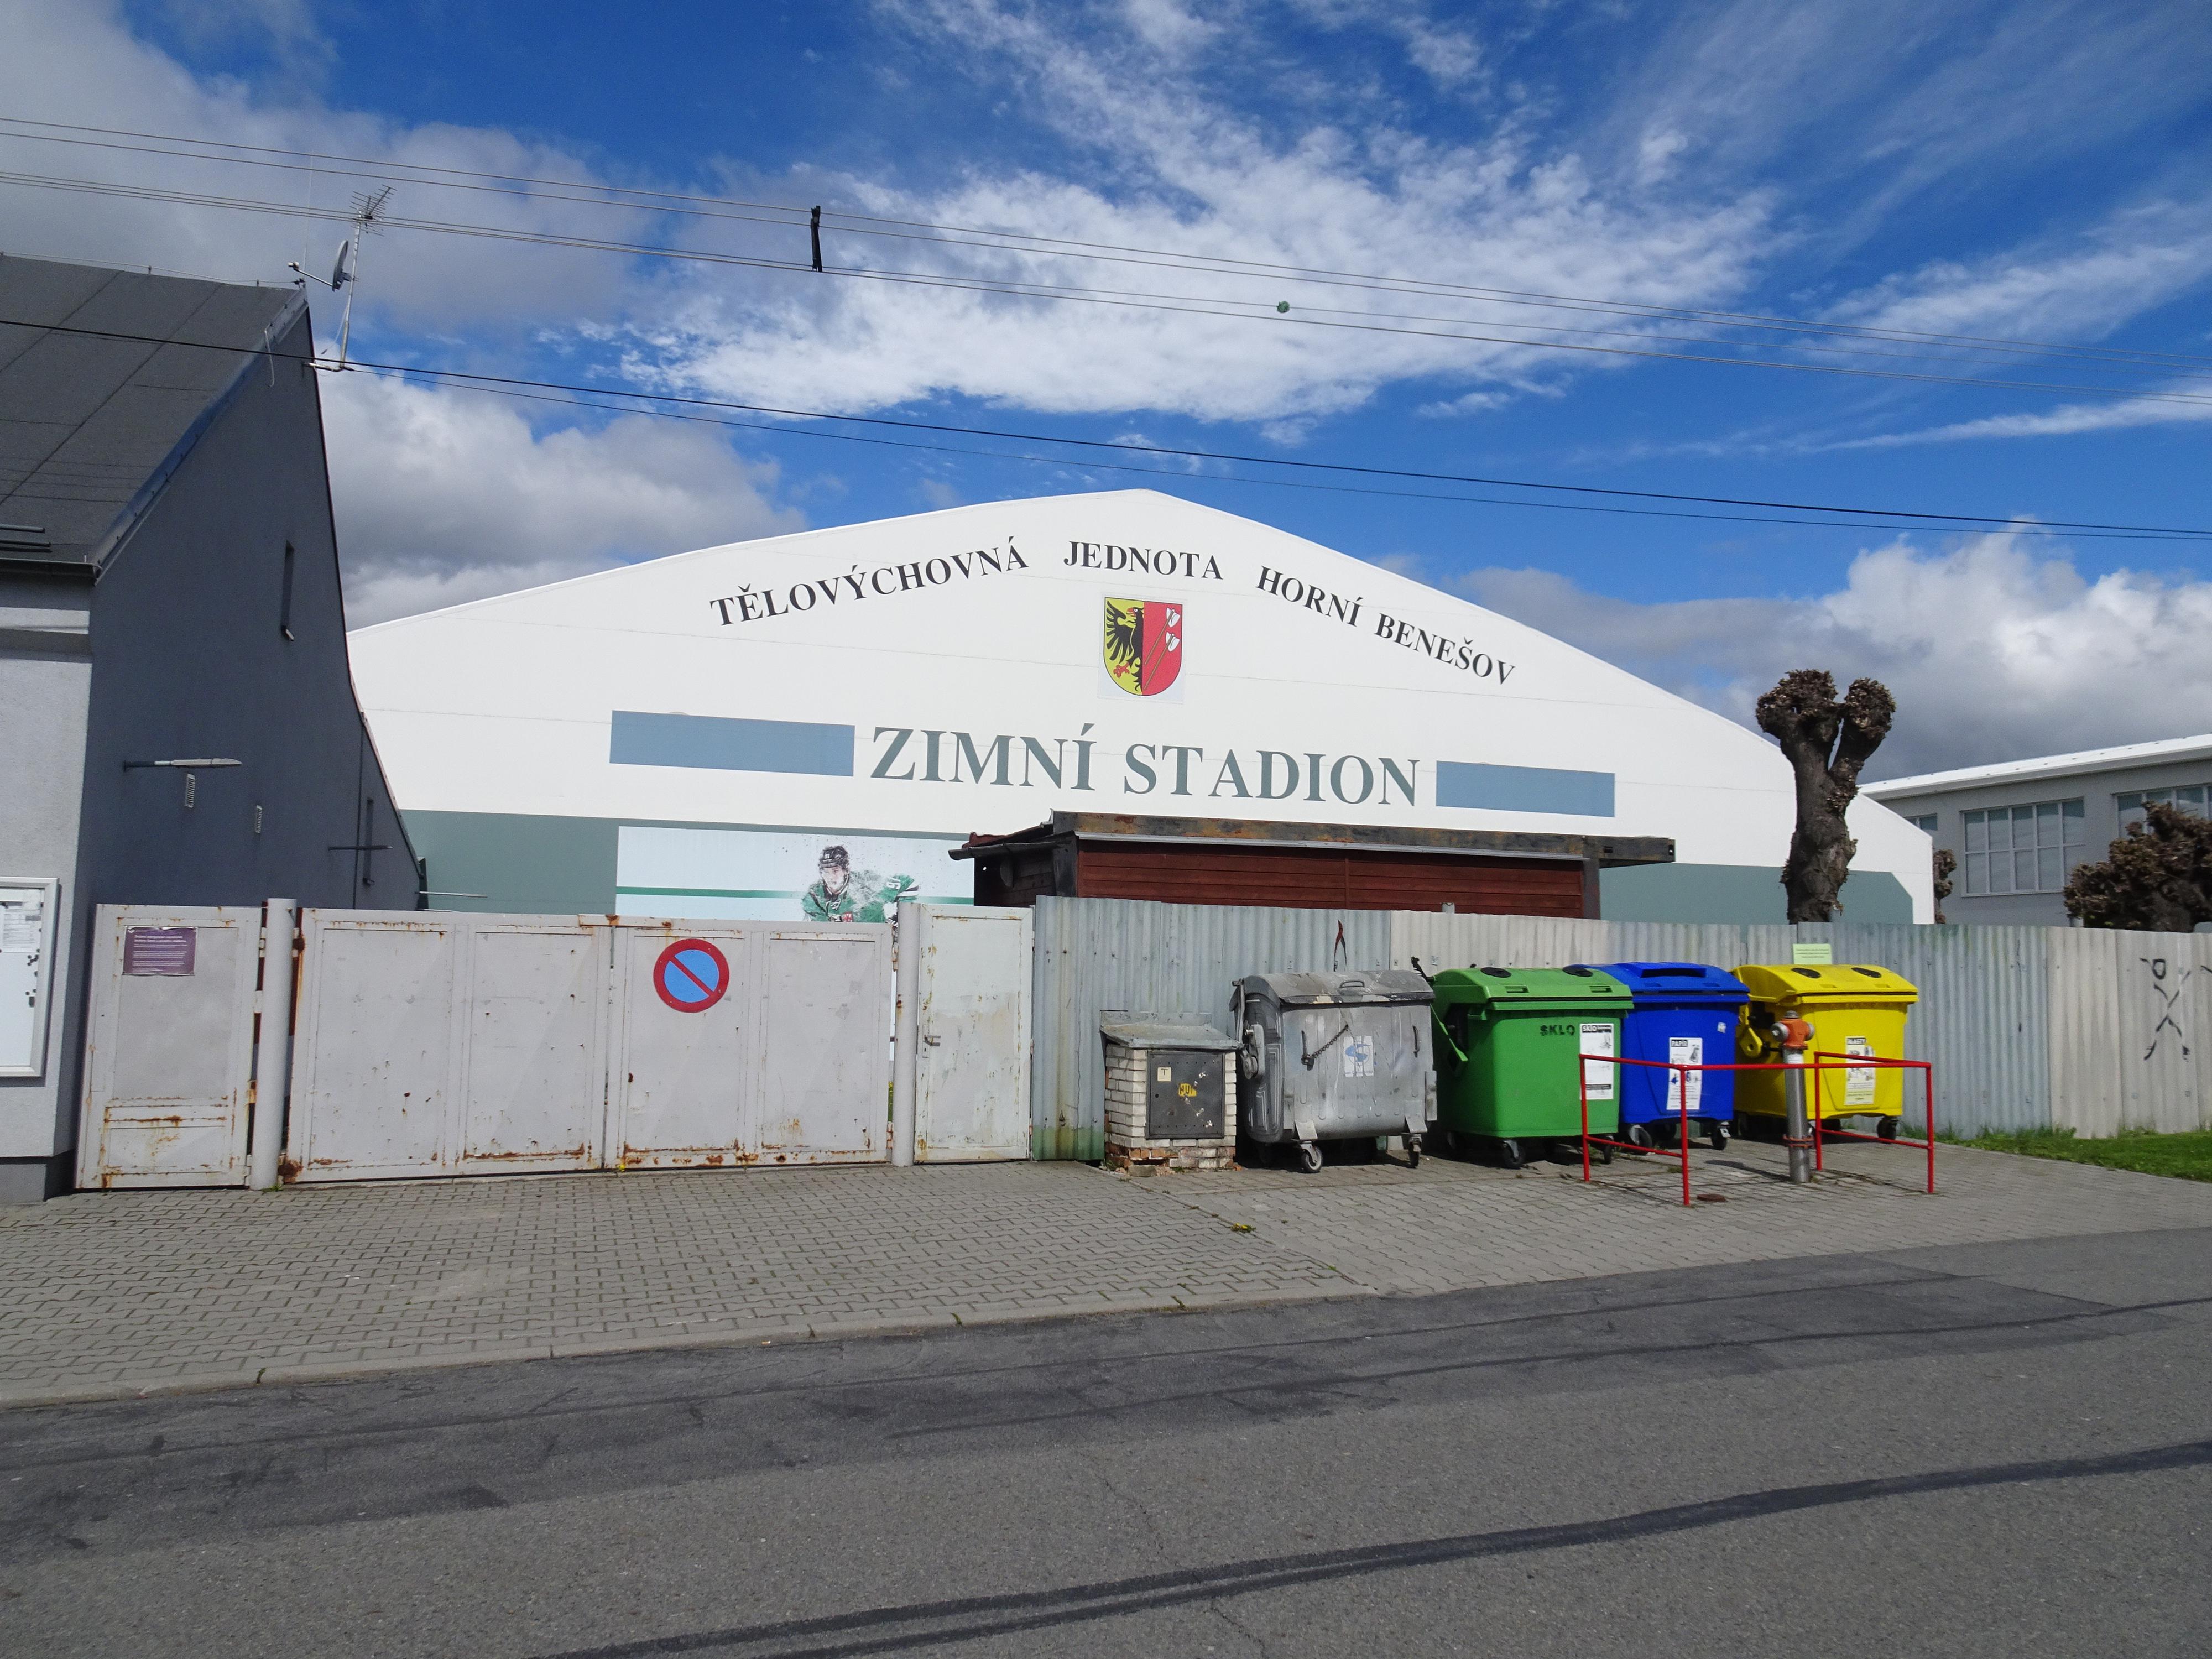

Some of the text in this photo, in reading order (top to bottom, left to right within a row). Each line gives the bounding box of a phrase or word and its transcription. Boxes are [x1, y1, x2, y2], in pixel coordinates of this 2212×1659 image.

[709, 535, 1516, 685] TĚLOVÝCHOVNÁ JEDNOTA HORNÍ BENEŠOV
[870, 723, 1420, 807] ZIMNÍ STADION
[1540, 1025, 1575, 1036] SKLO
